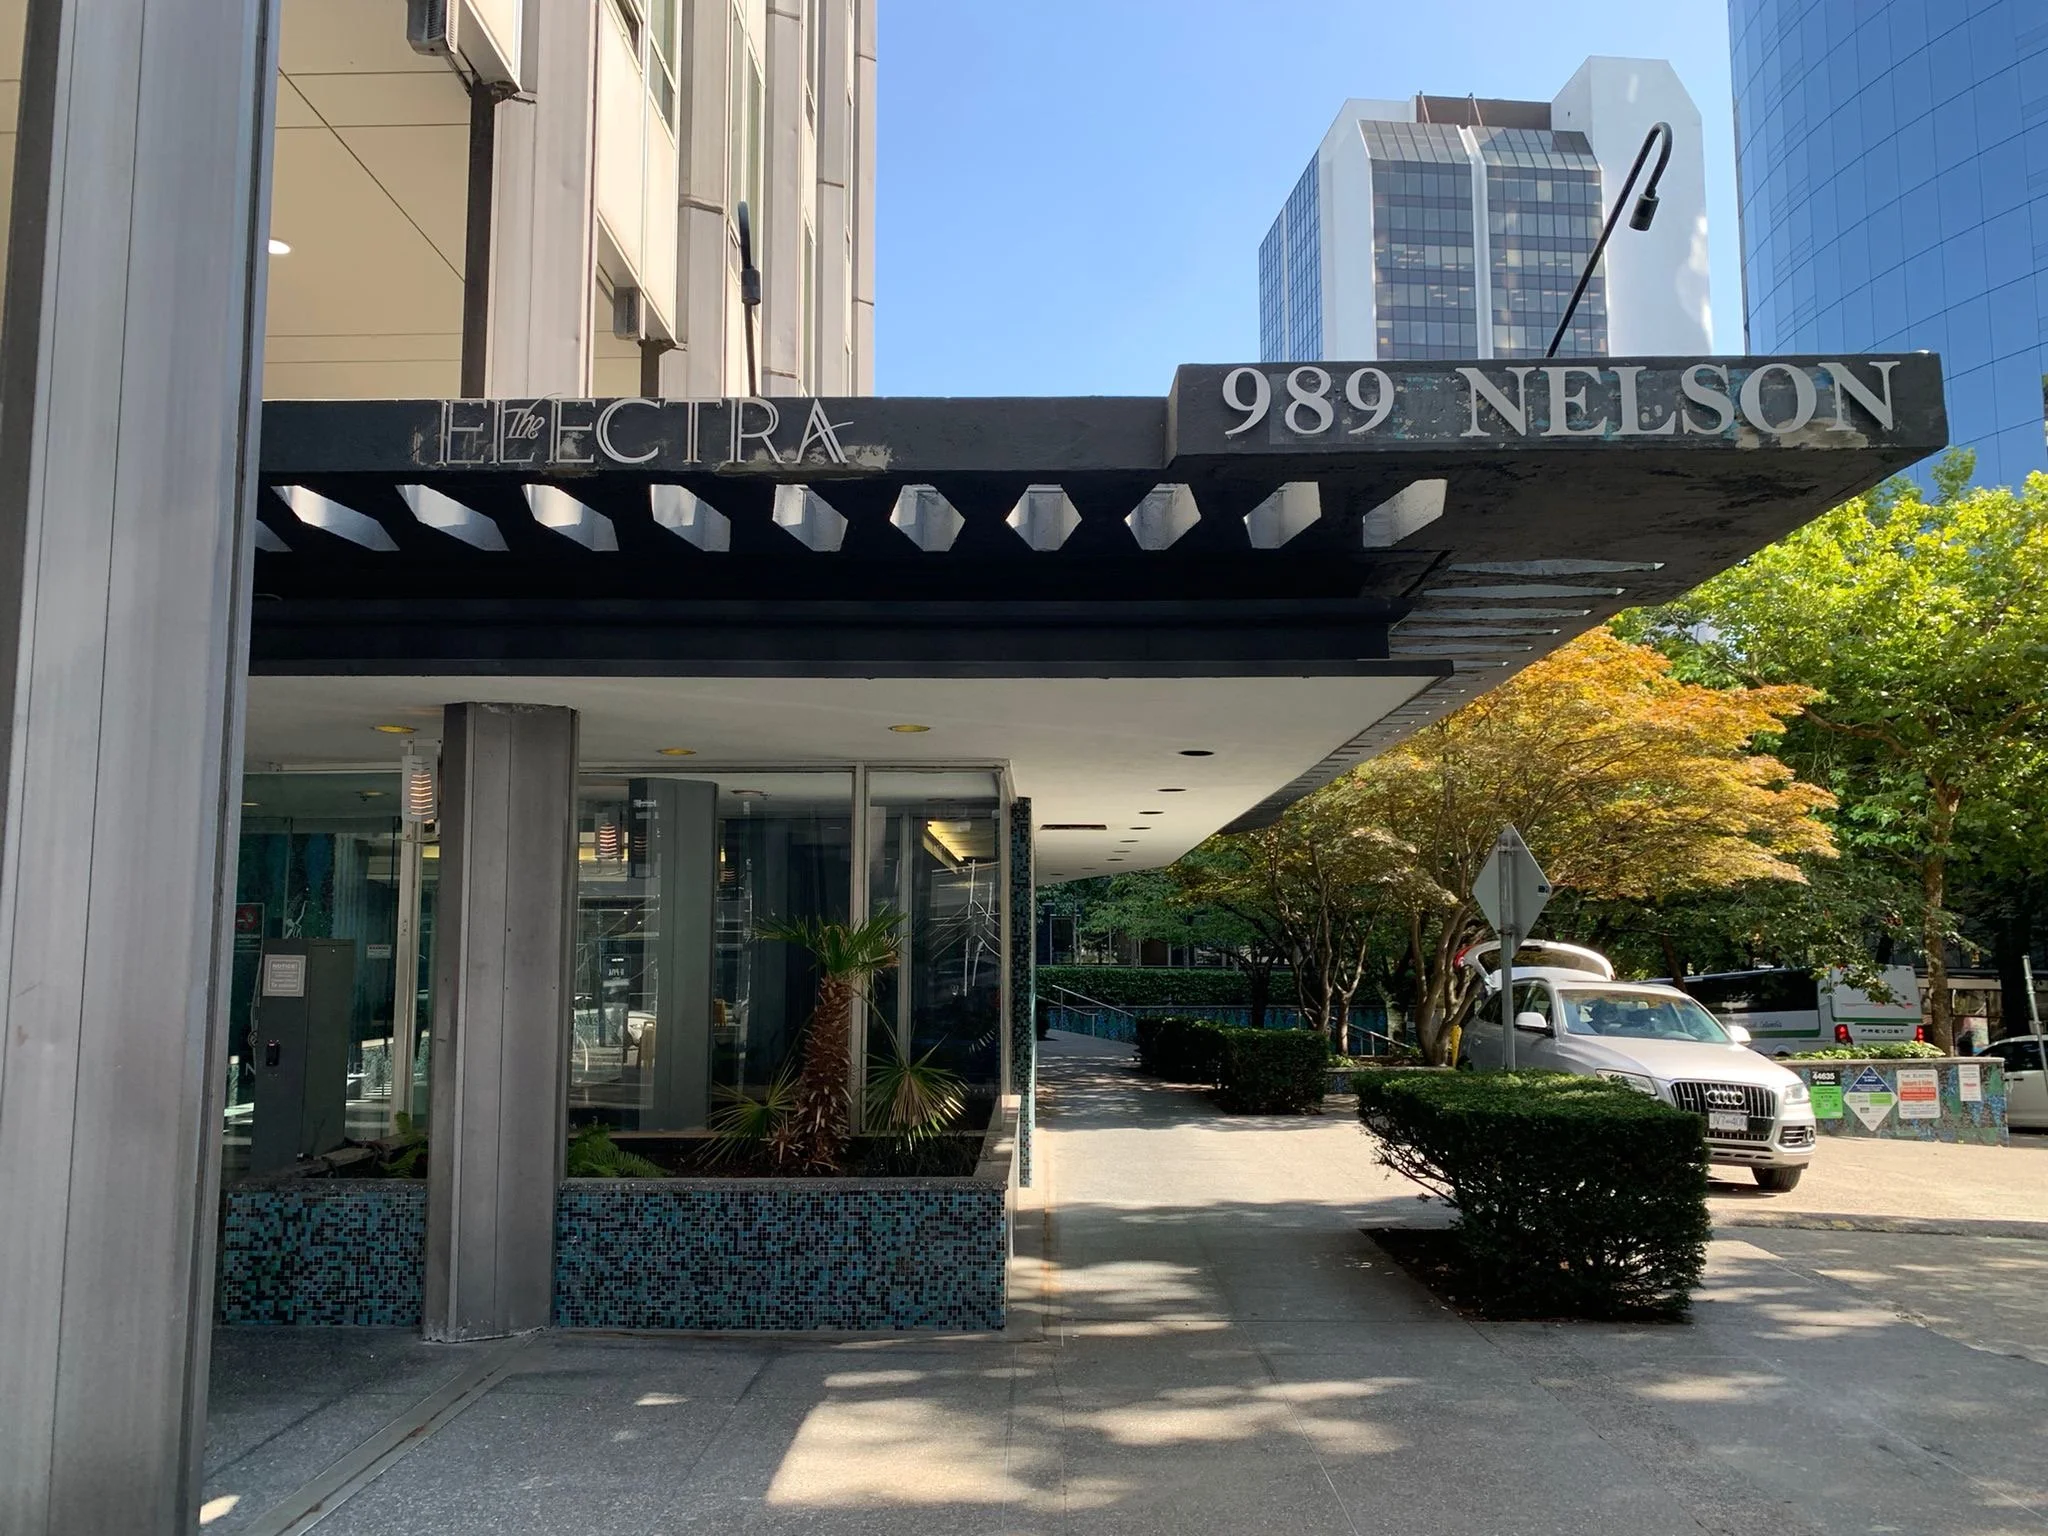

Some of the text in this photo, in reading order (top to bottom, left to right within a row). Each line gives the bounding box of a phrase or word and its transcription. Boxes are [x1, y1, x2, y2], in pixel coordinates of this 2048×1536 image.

[437, 397, 854, 465] ELECTRA
[504, 395, 555, 439] The
[1221, 361, 1901, 438] 989 NELSON
